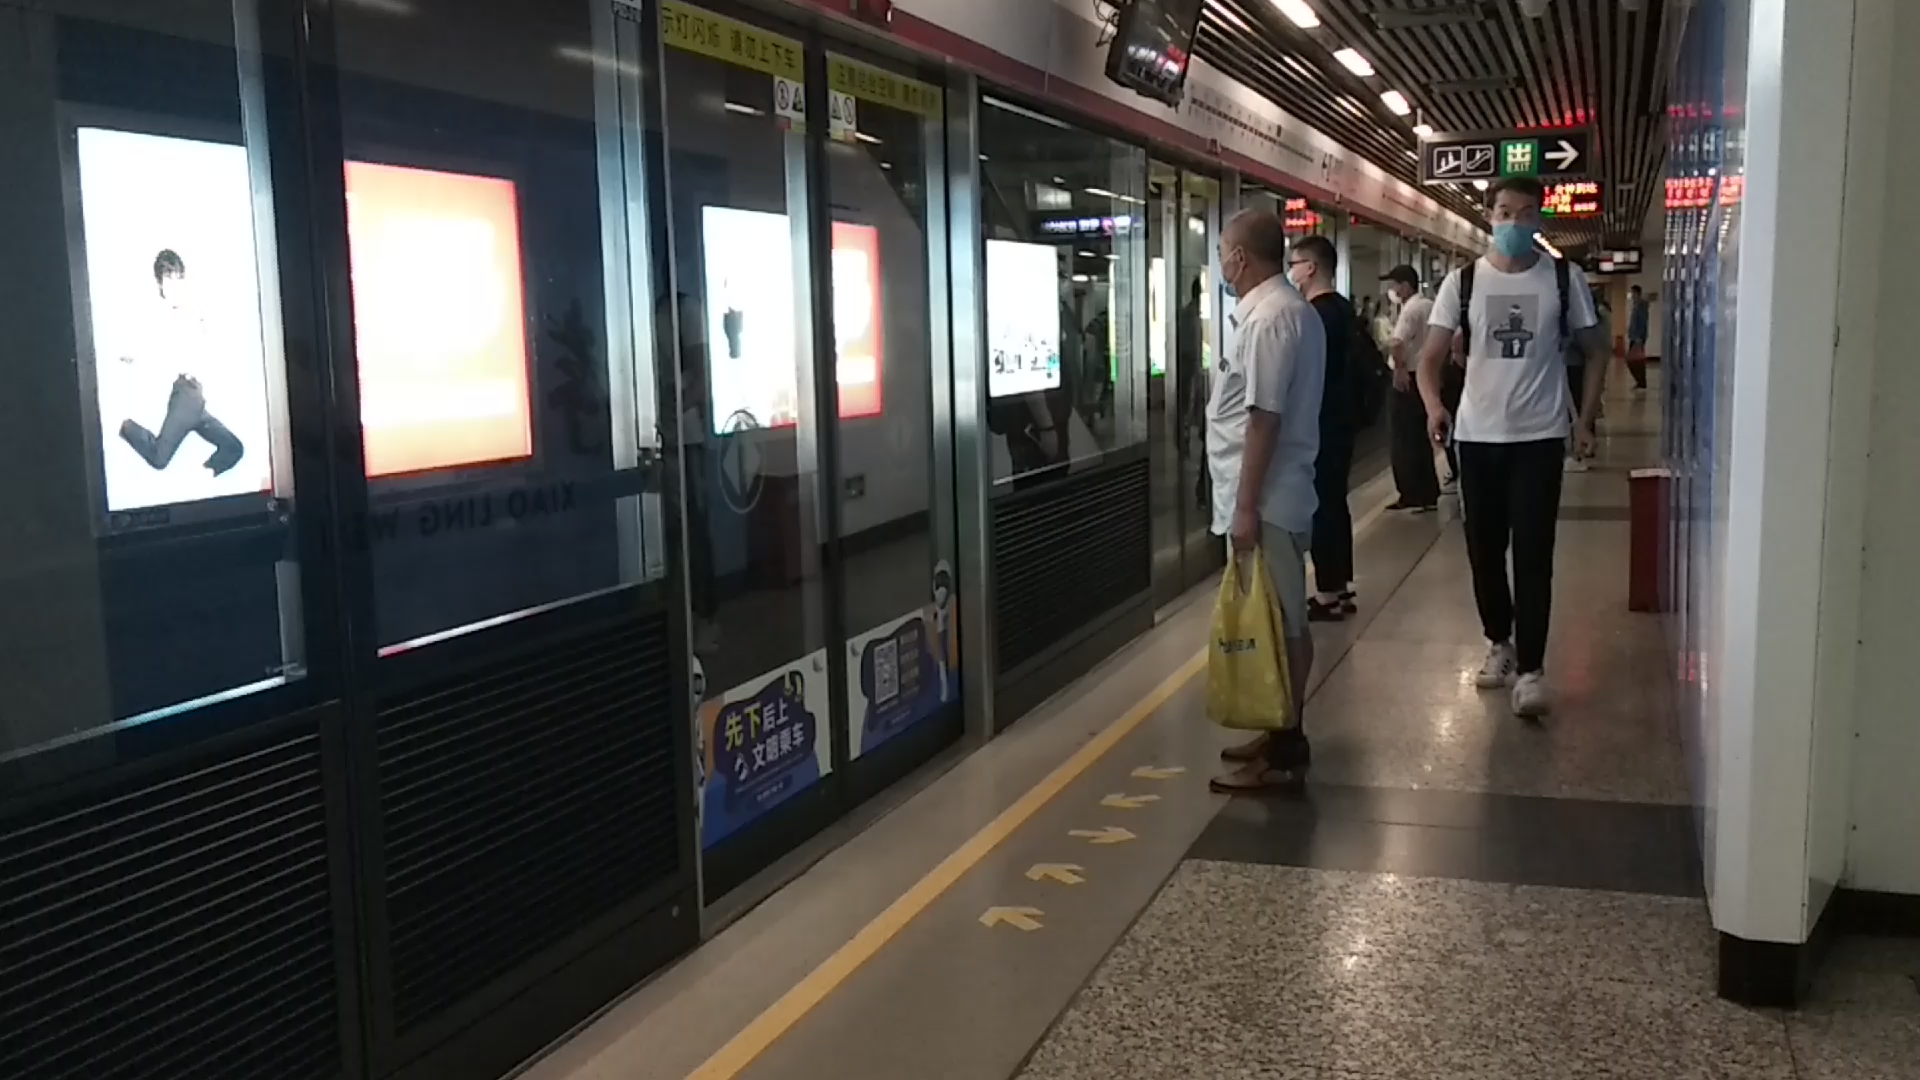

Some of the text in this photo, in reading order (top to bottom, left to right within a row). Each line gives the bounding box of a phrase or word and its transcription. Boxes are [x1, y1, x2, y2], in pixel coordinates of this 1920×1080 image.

[730, 27, 796, 71] 请勿上下车
[1506, 143, 1531, 162] 出
[1506, 161, 1530, 173] EXIT
[724, 698, 789, 752] 先下后上
[752, 722, 805, 771] 文明乘车
